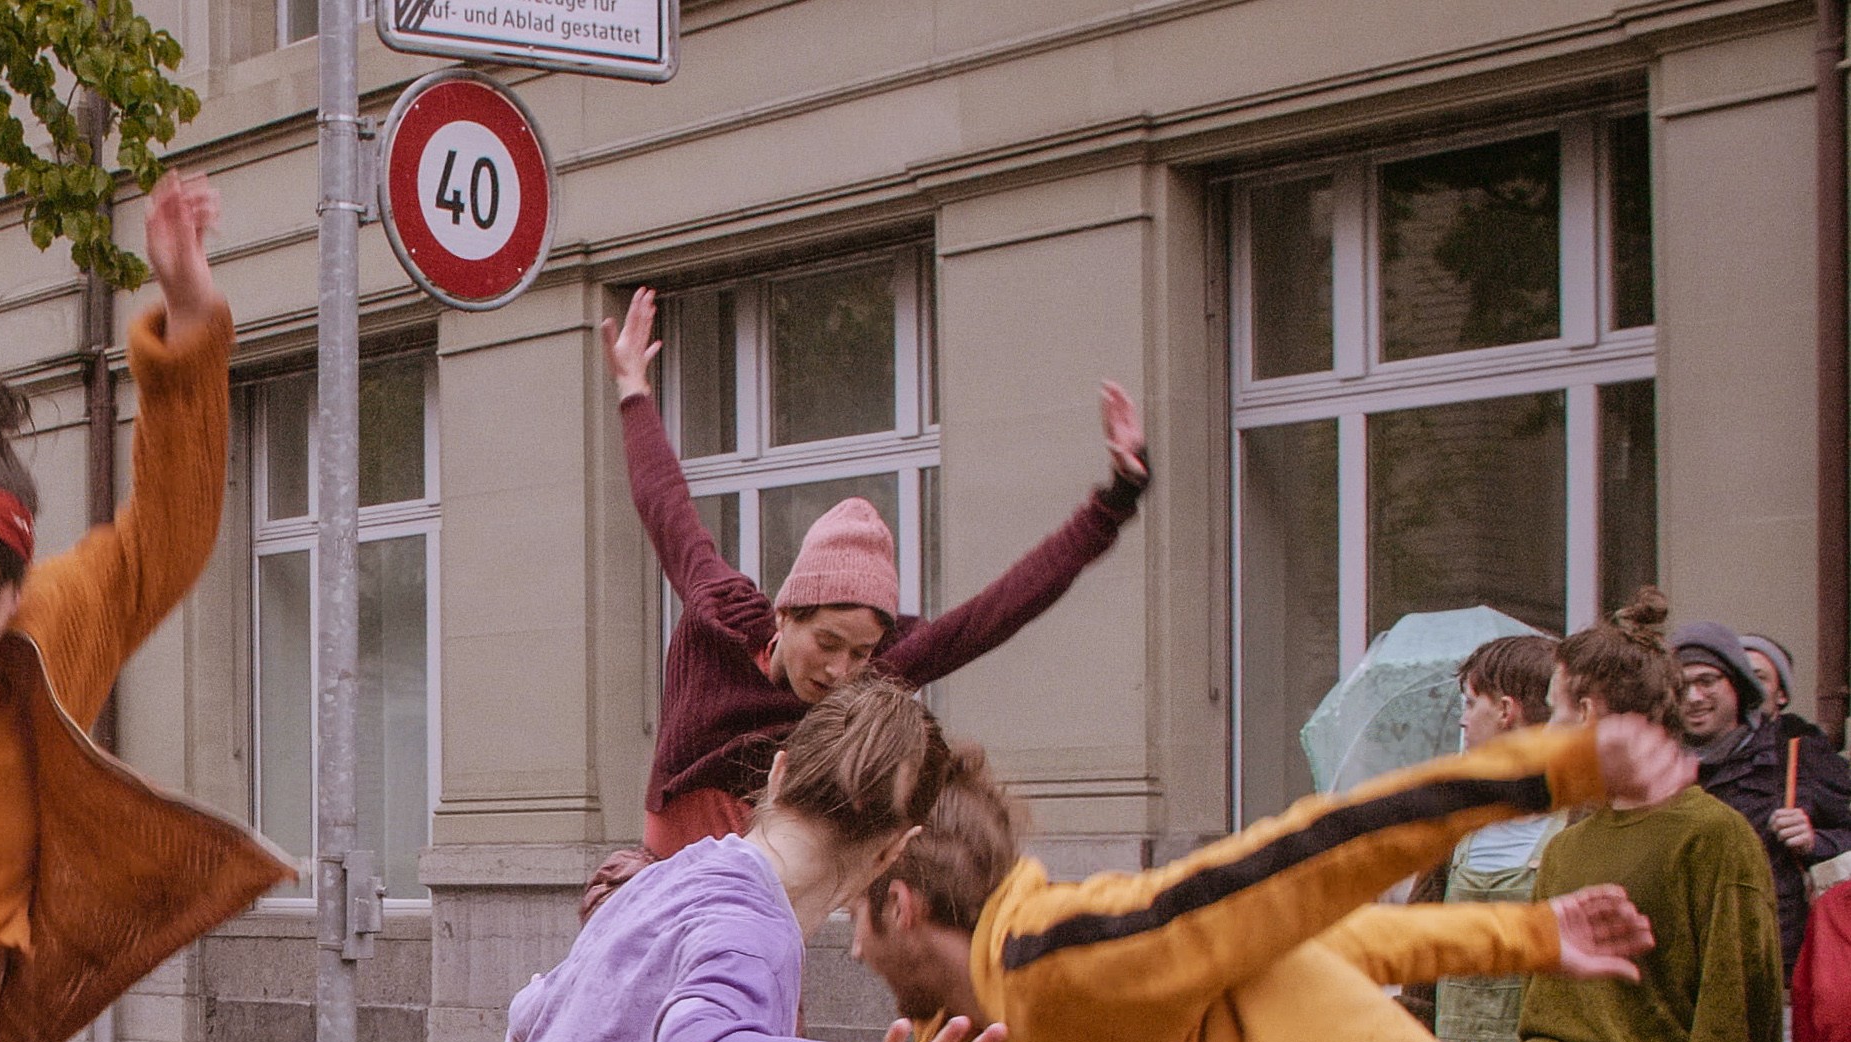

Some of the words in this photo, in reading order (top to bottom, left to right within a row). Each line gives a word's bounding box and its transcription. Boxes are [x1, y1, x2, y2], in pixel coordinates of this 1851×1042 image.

[464, 7, 497, 25] und
[502, 10, 554, 33] Ablad
[561, 21, 640, 44] gestattet
[435, 150, 499, 229] 40
